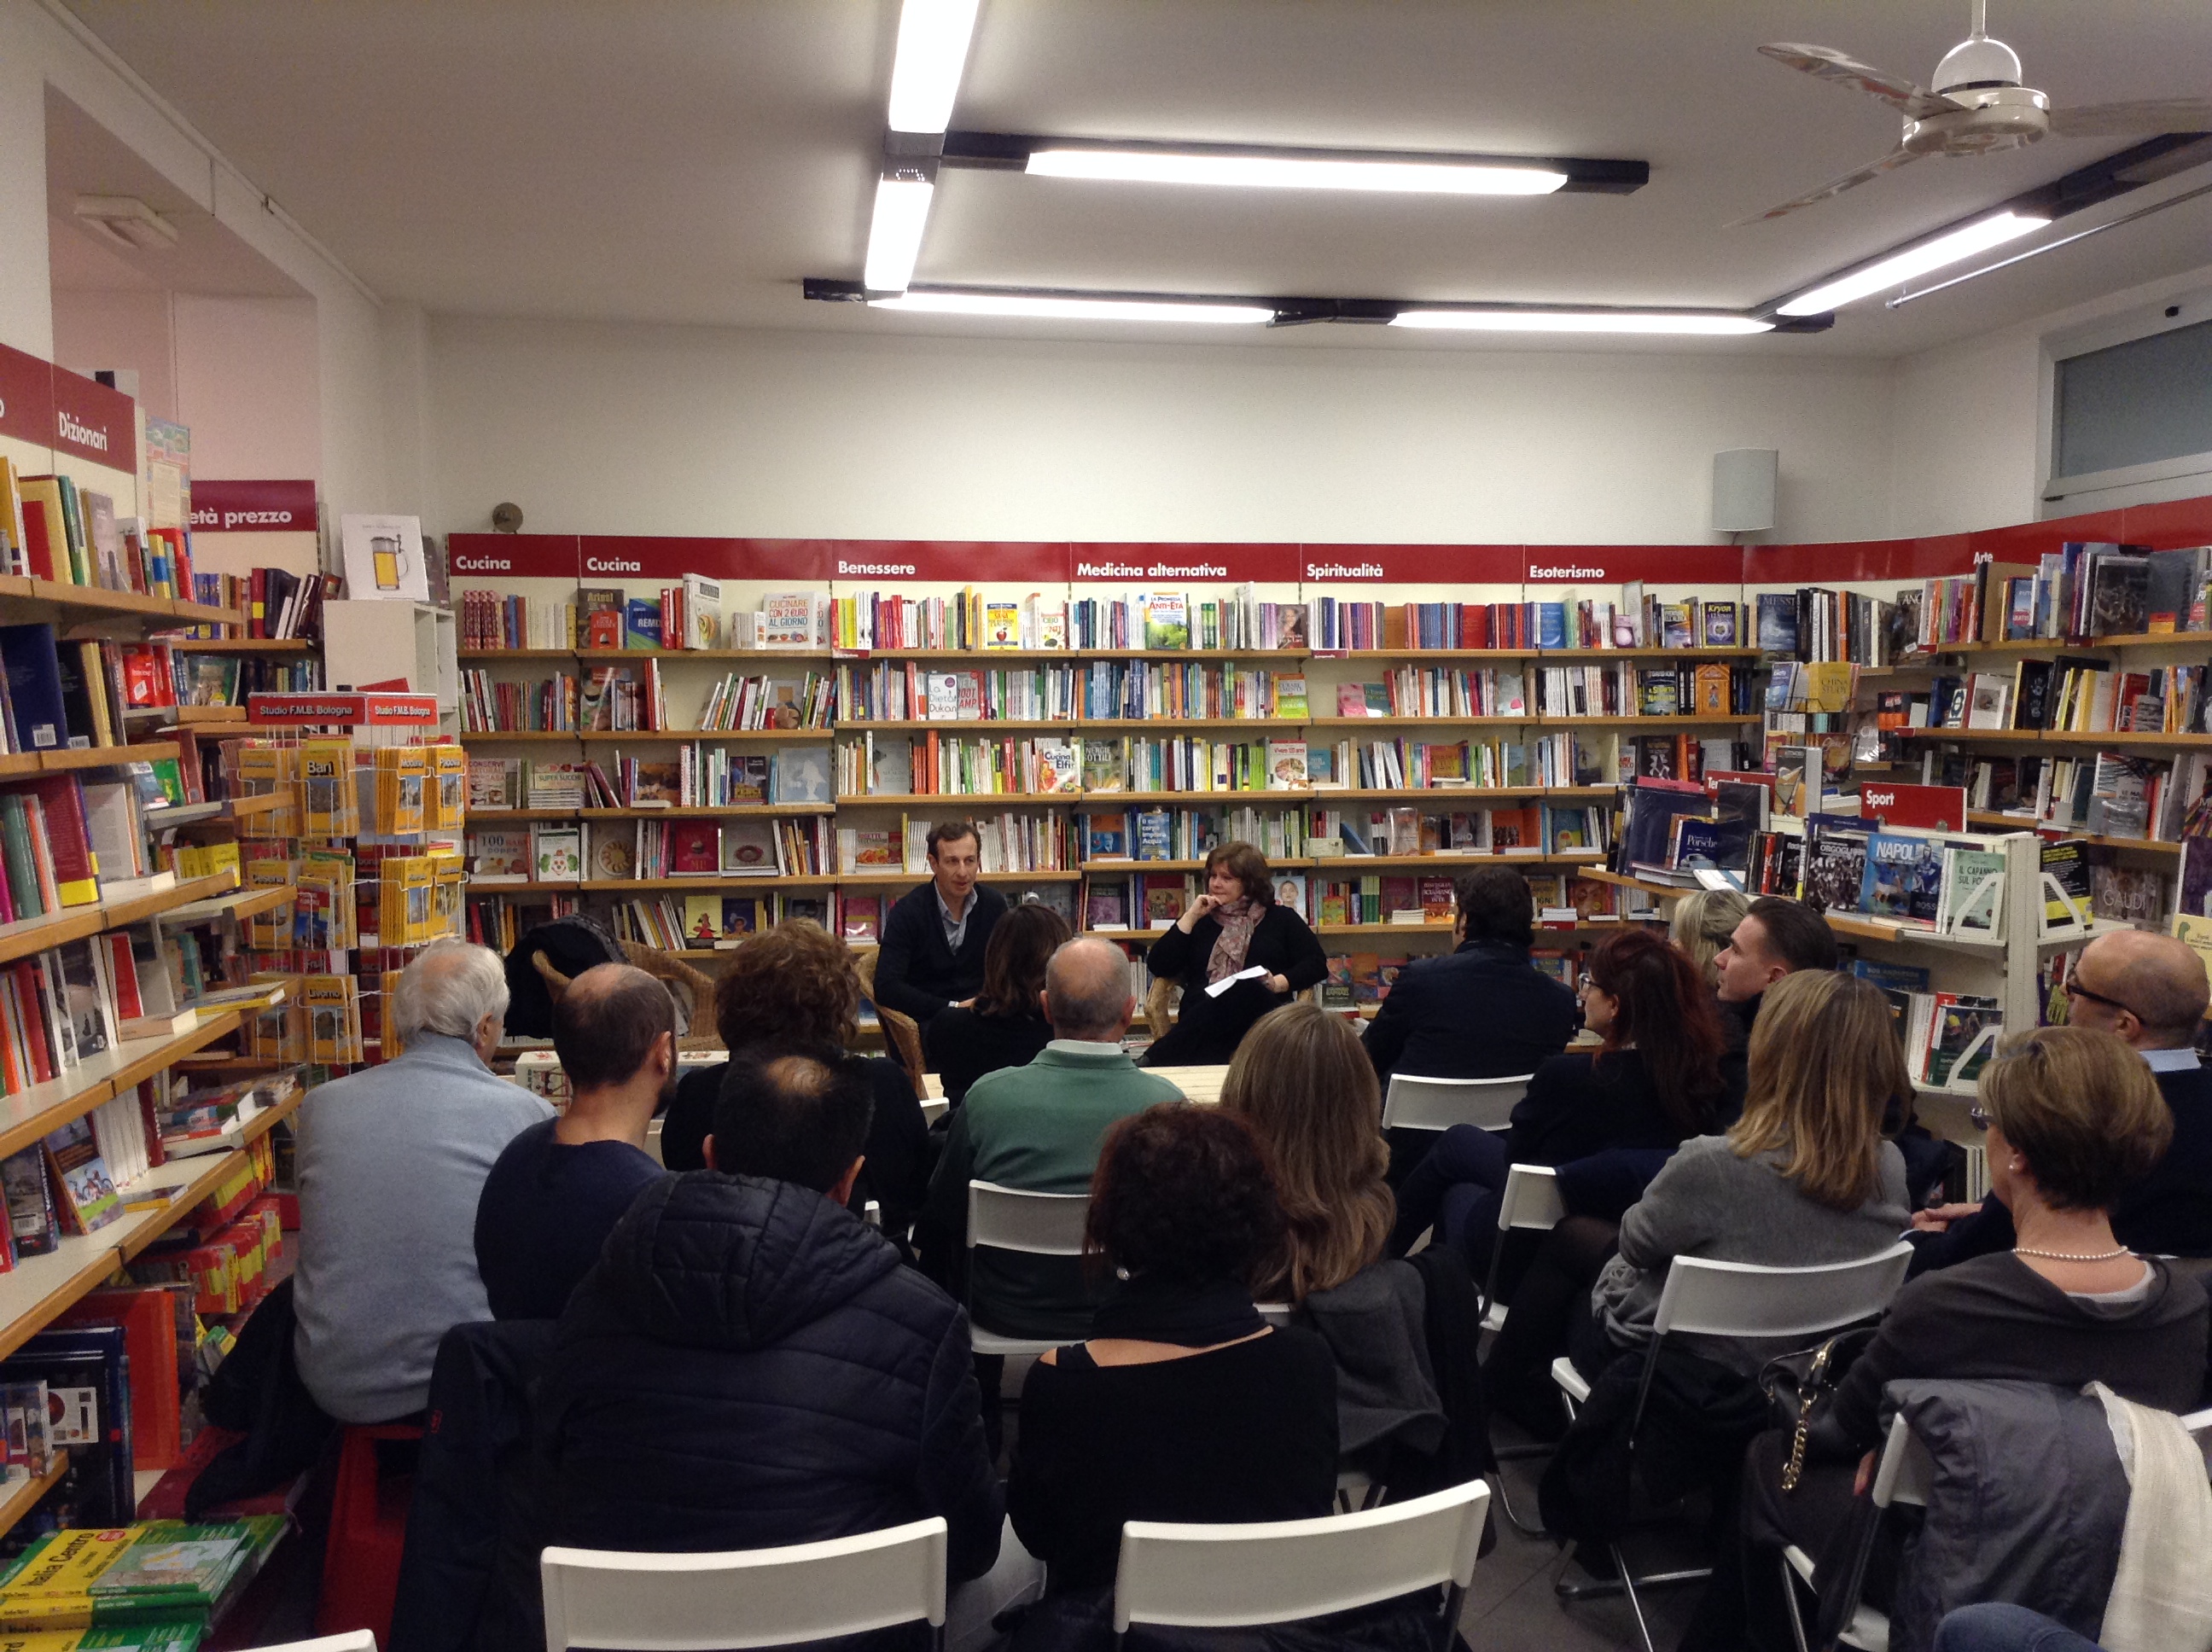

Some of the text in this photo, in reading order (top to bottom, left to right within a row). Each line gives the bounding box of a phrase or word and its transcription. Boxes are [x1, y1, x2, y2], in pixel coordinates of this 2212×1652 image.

[59, 411, 108, 451] Dizionari
[224, 510, 293, 529] prezzo
[456, 556, 511, 570] Cucina
[586, 556, 641, 572] Cucina
[1973, 551, 1994, 564] Arte
[838, 560, 916, 575] Benessere
[1077, 561, 1227, 577] Medicina alternativa
[1307, 563, 1383, 579] Spiritualità
[1529, 564, 1605, 579] Esoterismo
[769, 599, 808, 608] CUCINARE
[1708, 604, 1732, 614] Kryon
[769, 609, 783, 618] CON
[790, 608, 808, 617] EURO
[769, 617, 808, 627] AL GIORNO
[929, 703, 957, 713] Dukan
[958, 698, 977, 708] AMP
[259, 705, 352, 717] Studio F.M.B. Bologna
[375, 705, 393, 715] Studio
[410, 706, 430, 718] Bologna
[1045, 752, 1070, 760] Cucina
[307, 760, 334, 776] Bari
[1866, 789, 1895, 809] Sport
[482, 837, 504, 846] 100
[1686, 835, 1718, 848] Porsche
[308, 989, 341, 999] Livorno
[49, 1533, 95, 1562] Centro
